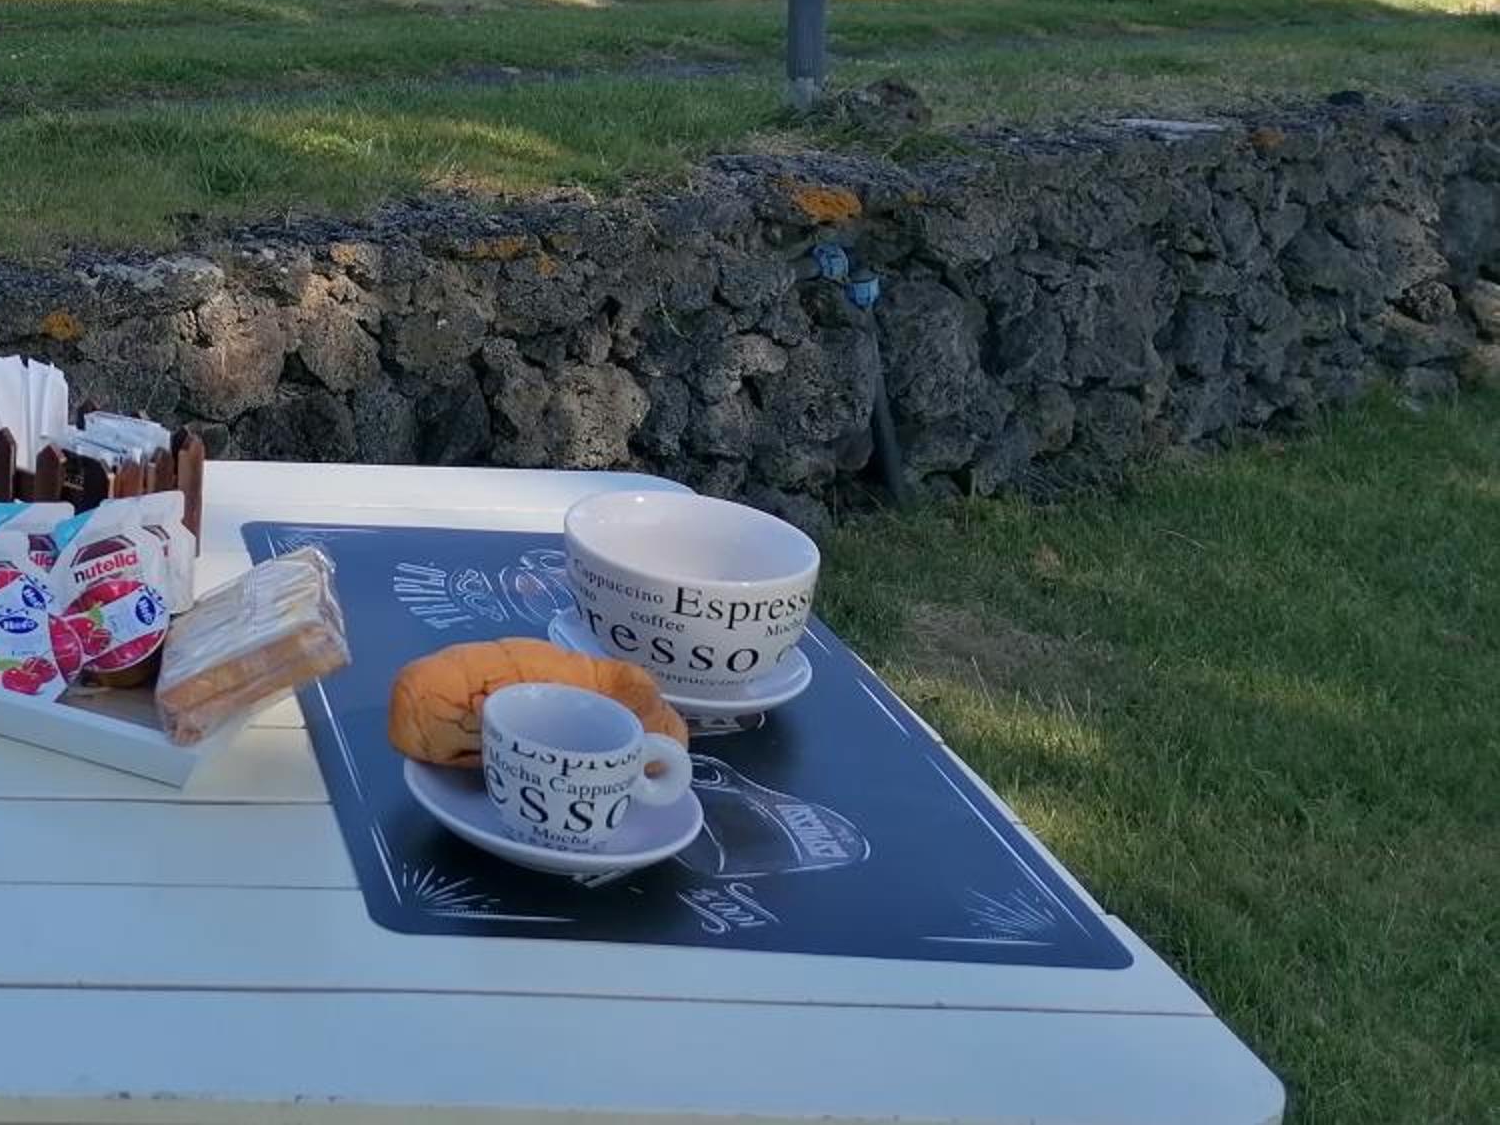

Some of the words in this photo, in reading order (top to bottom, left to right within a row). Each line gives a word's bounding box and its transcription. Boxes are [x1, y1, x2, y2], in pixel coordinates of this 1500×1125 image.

[73, 550, 139, 584] nutella
[573, 558, 664, 605] Cappuccino
[630, 609, 686, 633] coffee
[671, 586, 812, 630] Espress
